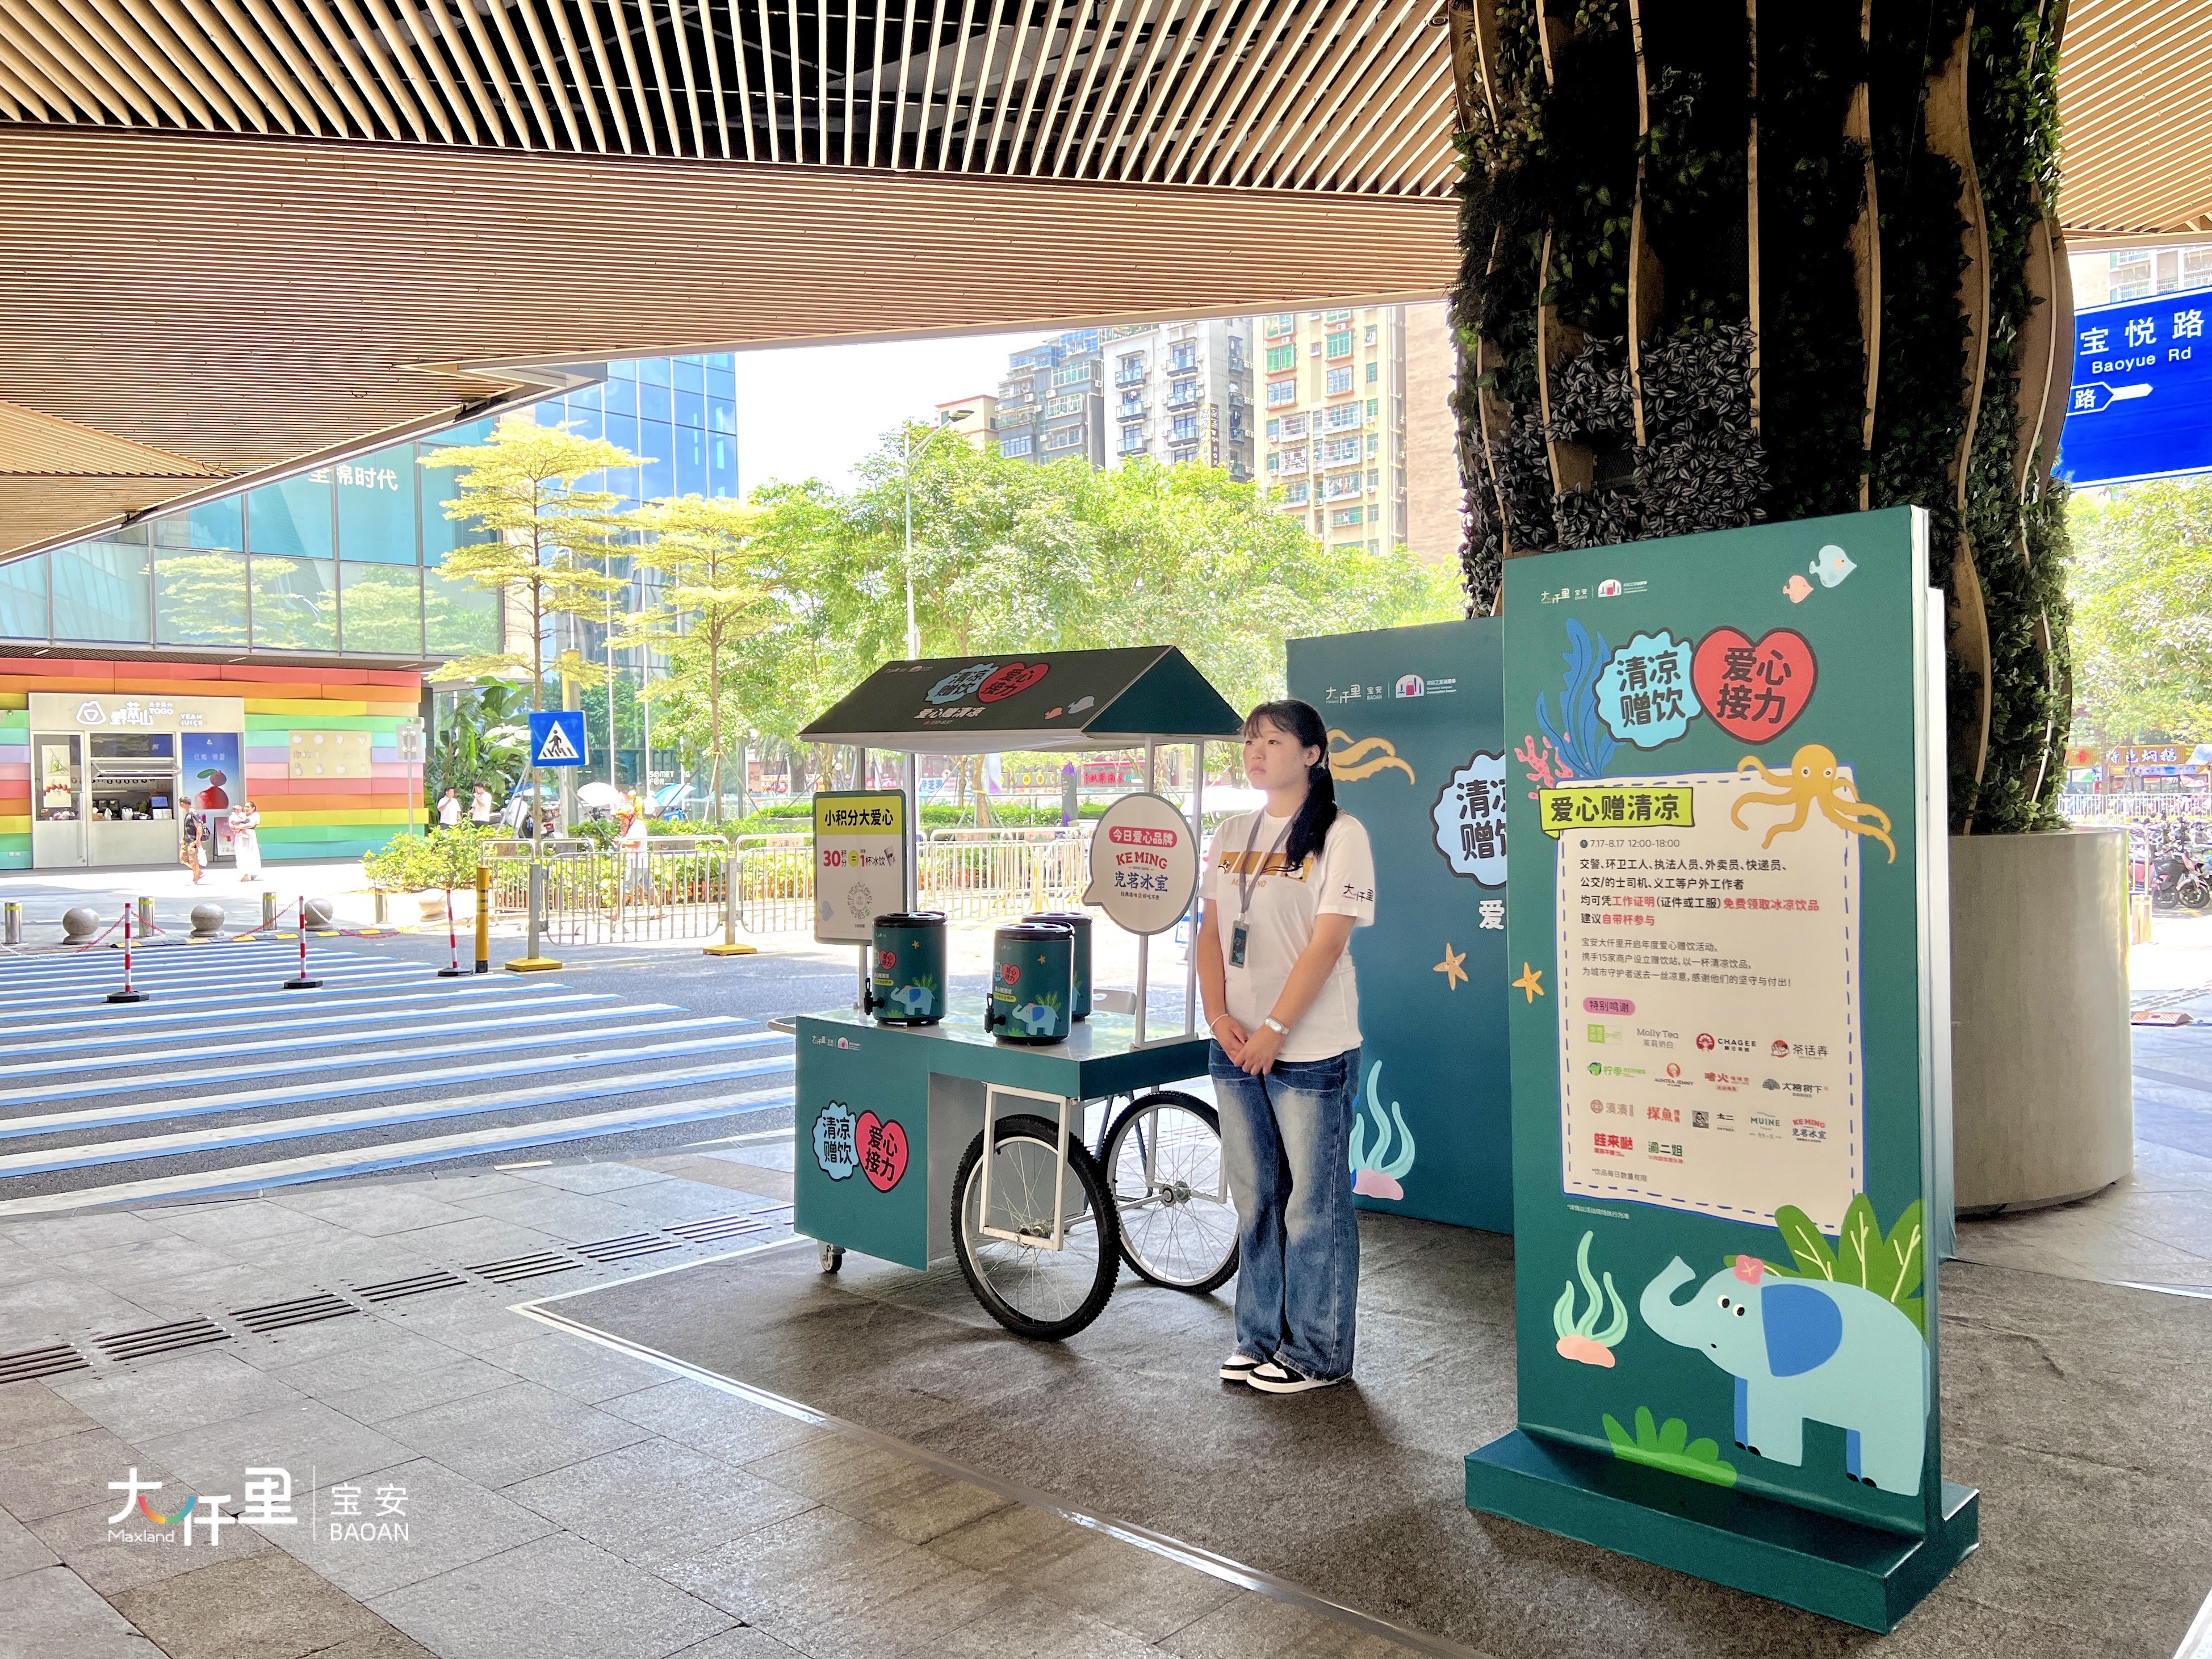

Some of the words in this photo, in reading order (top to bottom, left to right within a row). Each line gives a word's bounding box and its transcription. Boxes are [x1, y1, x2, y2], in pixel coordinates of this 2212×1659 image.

[2080, 309, 2205, 356] 宝悦路
[2092, 354, 2156, 375] Baoyue
[2168, 346, 2192, 362] Rd
[2073, 388, 2097, 410] 路
[1616, 650, 1681, 692] 清凉
[1721, 647, 1792, 686] 爱心
[1325, 684, 1362, 705] 大仟里
[1716, 682, 1786, 724] 接力
[1619, 686, 1686, 728] 赠饮
[824, 808, 894, 827] 小积分大爱心
[1551, 793, 1679, 822] 爱心赠清凉
[1112, 828, 1174, 847] 今日爱心品牌
[1590, 839, 1624, 848] 7.17-8.17
[1628, 839, 1680, 848] 12:00-18:00
[823, 850, 841, 867] 30
[1580, 857, 1787, 872] 交警、环卫工人、执法人员、外卖员、快递员、
[1114, 870, 1168, 893] 克茗冰室
[1580, 877, 1745, 890] 公交/的士司机、义工等户外工作者
[1478, 899, 1505, 931] 爱
[1580, 913, 1656, 927] 建议自带杯参与
[1589, 1000, 1629, 1013] 特别鸣谢
[1636, 1028, 1661, 1039] Molly
[1662, 1030, 1679, 1039] Tea
[1717, 1038, 1757, 1047] CHAGEE
[1792, 1044, 1829, 1057] 茶话弄
[822, 1116, 851, 1140] 清凉
[1750, 1116, 1781, 1127] MUINE
[868, 1125, 898, 1157] 爱心
[823, 1141, 852, 1165] 赠饮
[865, 1147, 895, 1182] 接力
